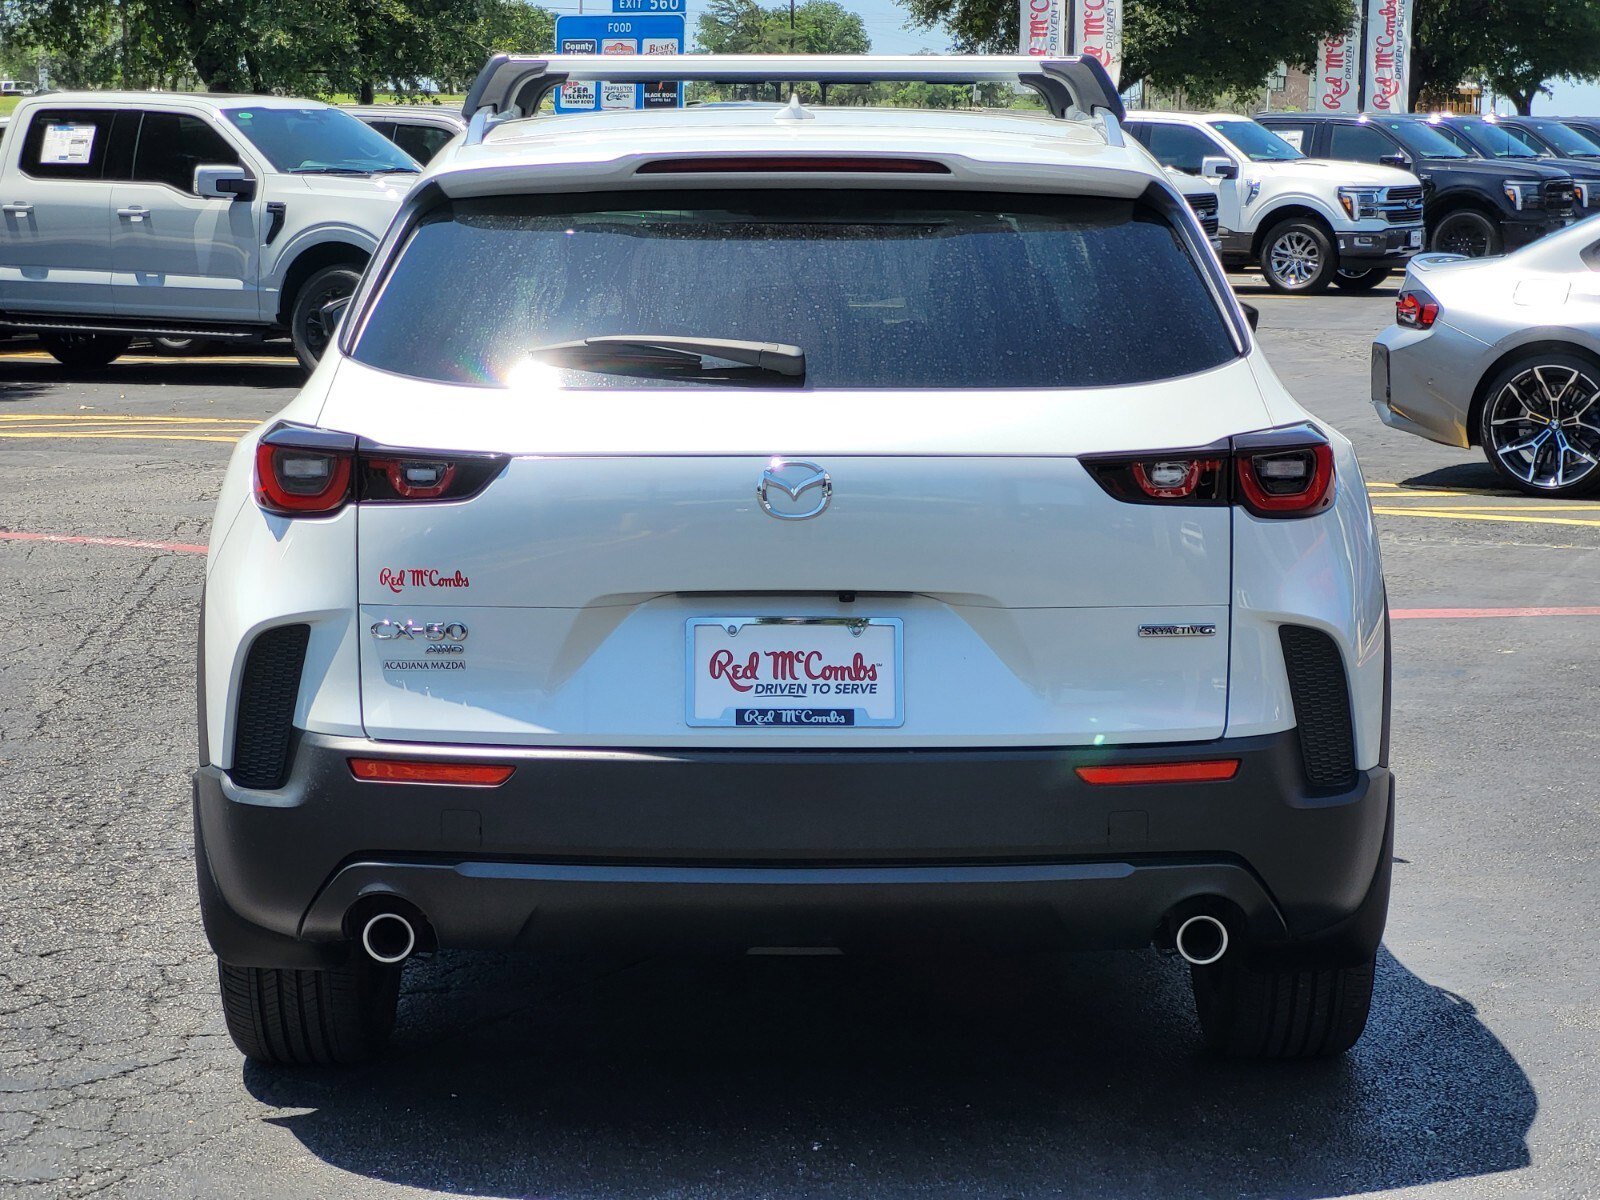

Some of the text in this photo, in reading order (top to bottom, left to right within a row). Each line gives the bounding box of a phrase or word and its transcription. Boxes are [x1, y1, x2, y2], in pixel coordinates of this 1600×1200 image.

[619, 0, 679, 10] EXIT 560
[608, 23, 632, 33] FOOD
[1049, 10, 1058, 51] DRIVEN
[1105, 8, 1114, 50] DRIVEN
[1396, 30, 1403, 42] TO
[565, 42, 593, 51] County
[1372, 0, 1399, 110] Red McCombs
[1344, 45, 1353, 80] DRIVEN
[1394, 45, 1403, 80] DRIVEN
[1322, 76, 1350, 110] Red
[379, 567, 470, 593] Red McCombs
[370, 619, 469, 641] CX-50
[425, 643, 464, 654] AWD
[384, 661, 465, 670] ACADIANA MAZDA
[709, 649, 760, 693] Red
[764, 650, 877, 681] McCombs
[754, 683, 877, 695] DRIVEN TO SERVE
[744, 709, 845, 725] Red McCombs
